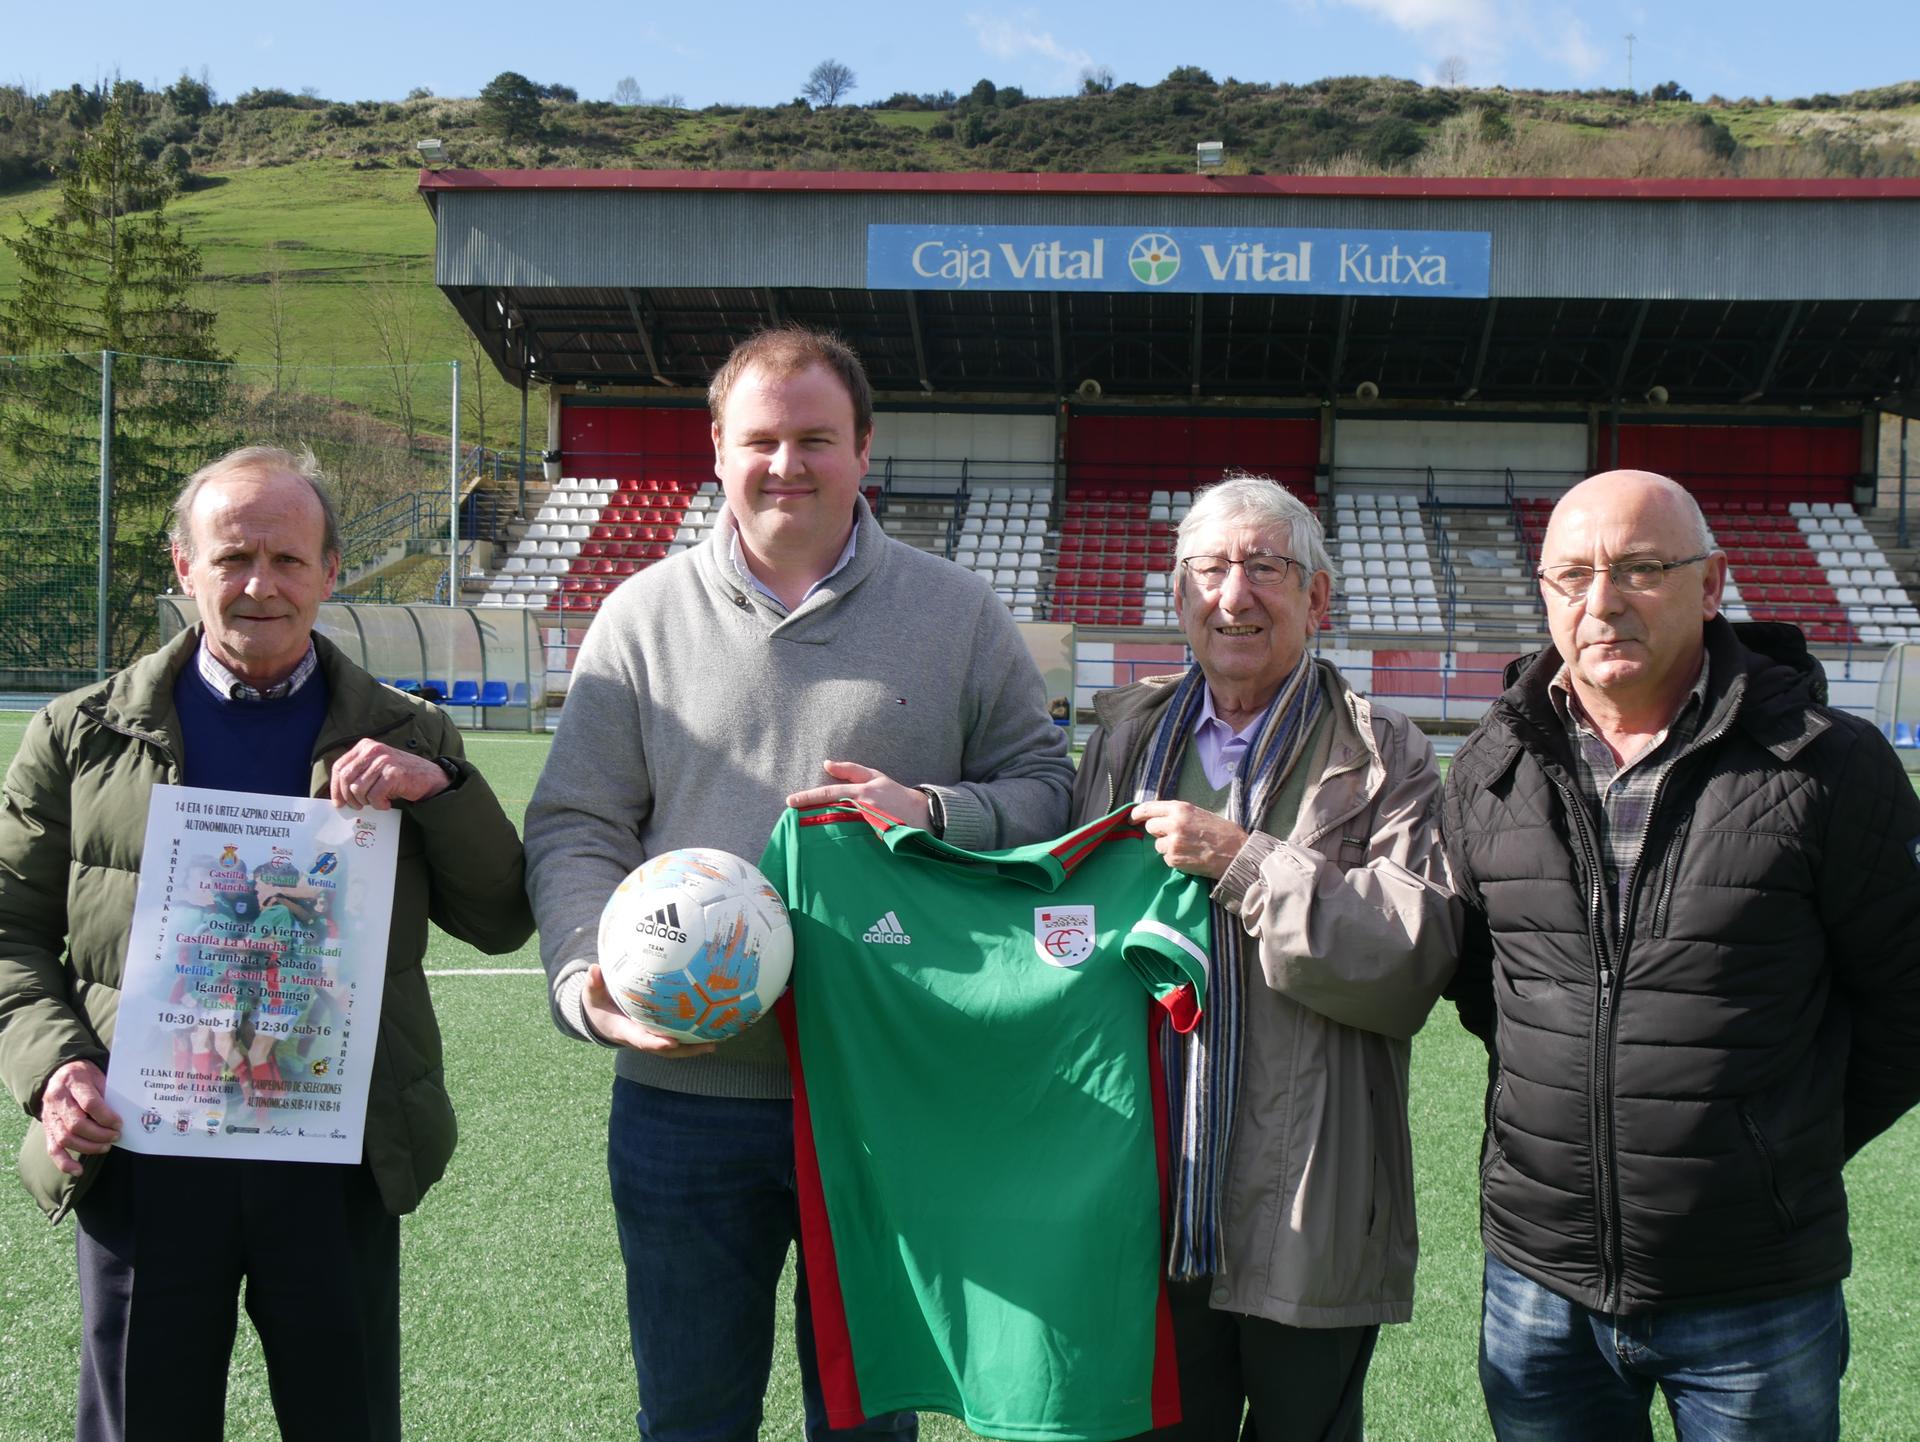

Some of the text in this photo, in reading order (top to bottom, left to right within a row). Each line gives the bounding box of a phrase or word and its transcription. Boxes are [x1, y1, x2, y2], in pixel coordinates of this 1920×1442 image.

[911, 238, 1447, 288] Caja Vital Vital Kutxa
[175, 801, 305, 823] 14 ETA 16 URTEZ AZPIKO SELEKZIO
[185, 820, 290, 838] AUTONOMIKOEN TXAPELKETA
[209, 869, 245, 881] Castilla
[260, 873, 297, 885] Euskadi
[307, 878, 337, 889] Melilla
[199, 881, 250, 893] La Mancha
[209, 920, 315, 940] Ostirala 6 Viernes
[635, 921, 688, 944] adidas
[862, 931, 912, 945] adidas
[175, 933, 220, 946] Castilla
[223, 936, 238, 947] La
[242, 939, 288, 952] Mancha
[299, 943, 342, 958] Euskadi
[648, 943, 665, 952] TEAM
[198, 950, 317, 970] Larunbata 7 Sabado
[175, 964, 214, 977] Melilla
[225, 968, 269, 982] Castilla
[273, 972, 287, 984] La
[291, 974, 334, 988] Mancha
[196, 982, 243, 997] Igandea
[259, 987, 310, 1001] Domingo
[203, 998, 250, 1011] Euskadi
[261, 1003, 298, 1016] Melilla
[158, 1012, 331, 1036] 10:30 sub-14 12:30 sub-16
[140, 1068, 184, 1079] ELLAKURI
[186, 1071, 213, 1081] futbol
[144, 1080, 234, 1094] Campo de ELLAKURI
[251, 1079, 342, 1095] CAMPEONATO DE SELECCIONES
[154, 1092, 184, 1102] Laudio
[194, 1096, 221, 1105] Llodio
[290, 1099, 312, 1110] SUB-14
[319, 1100, 341, 1112] SUB-16
